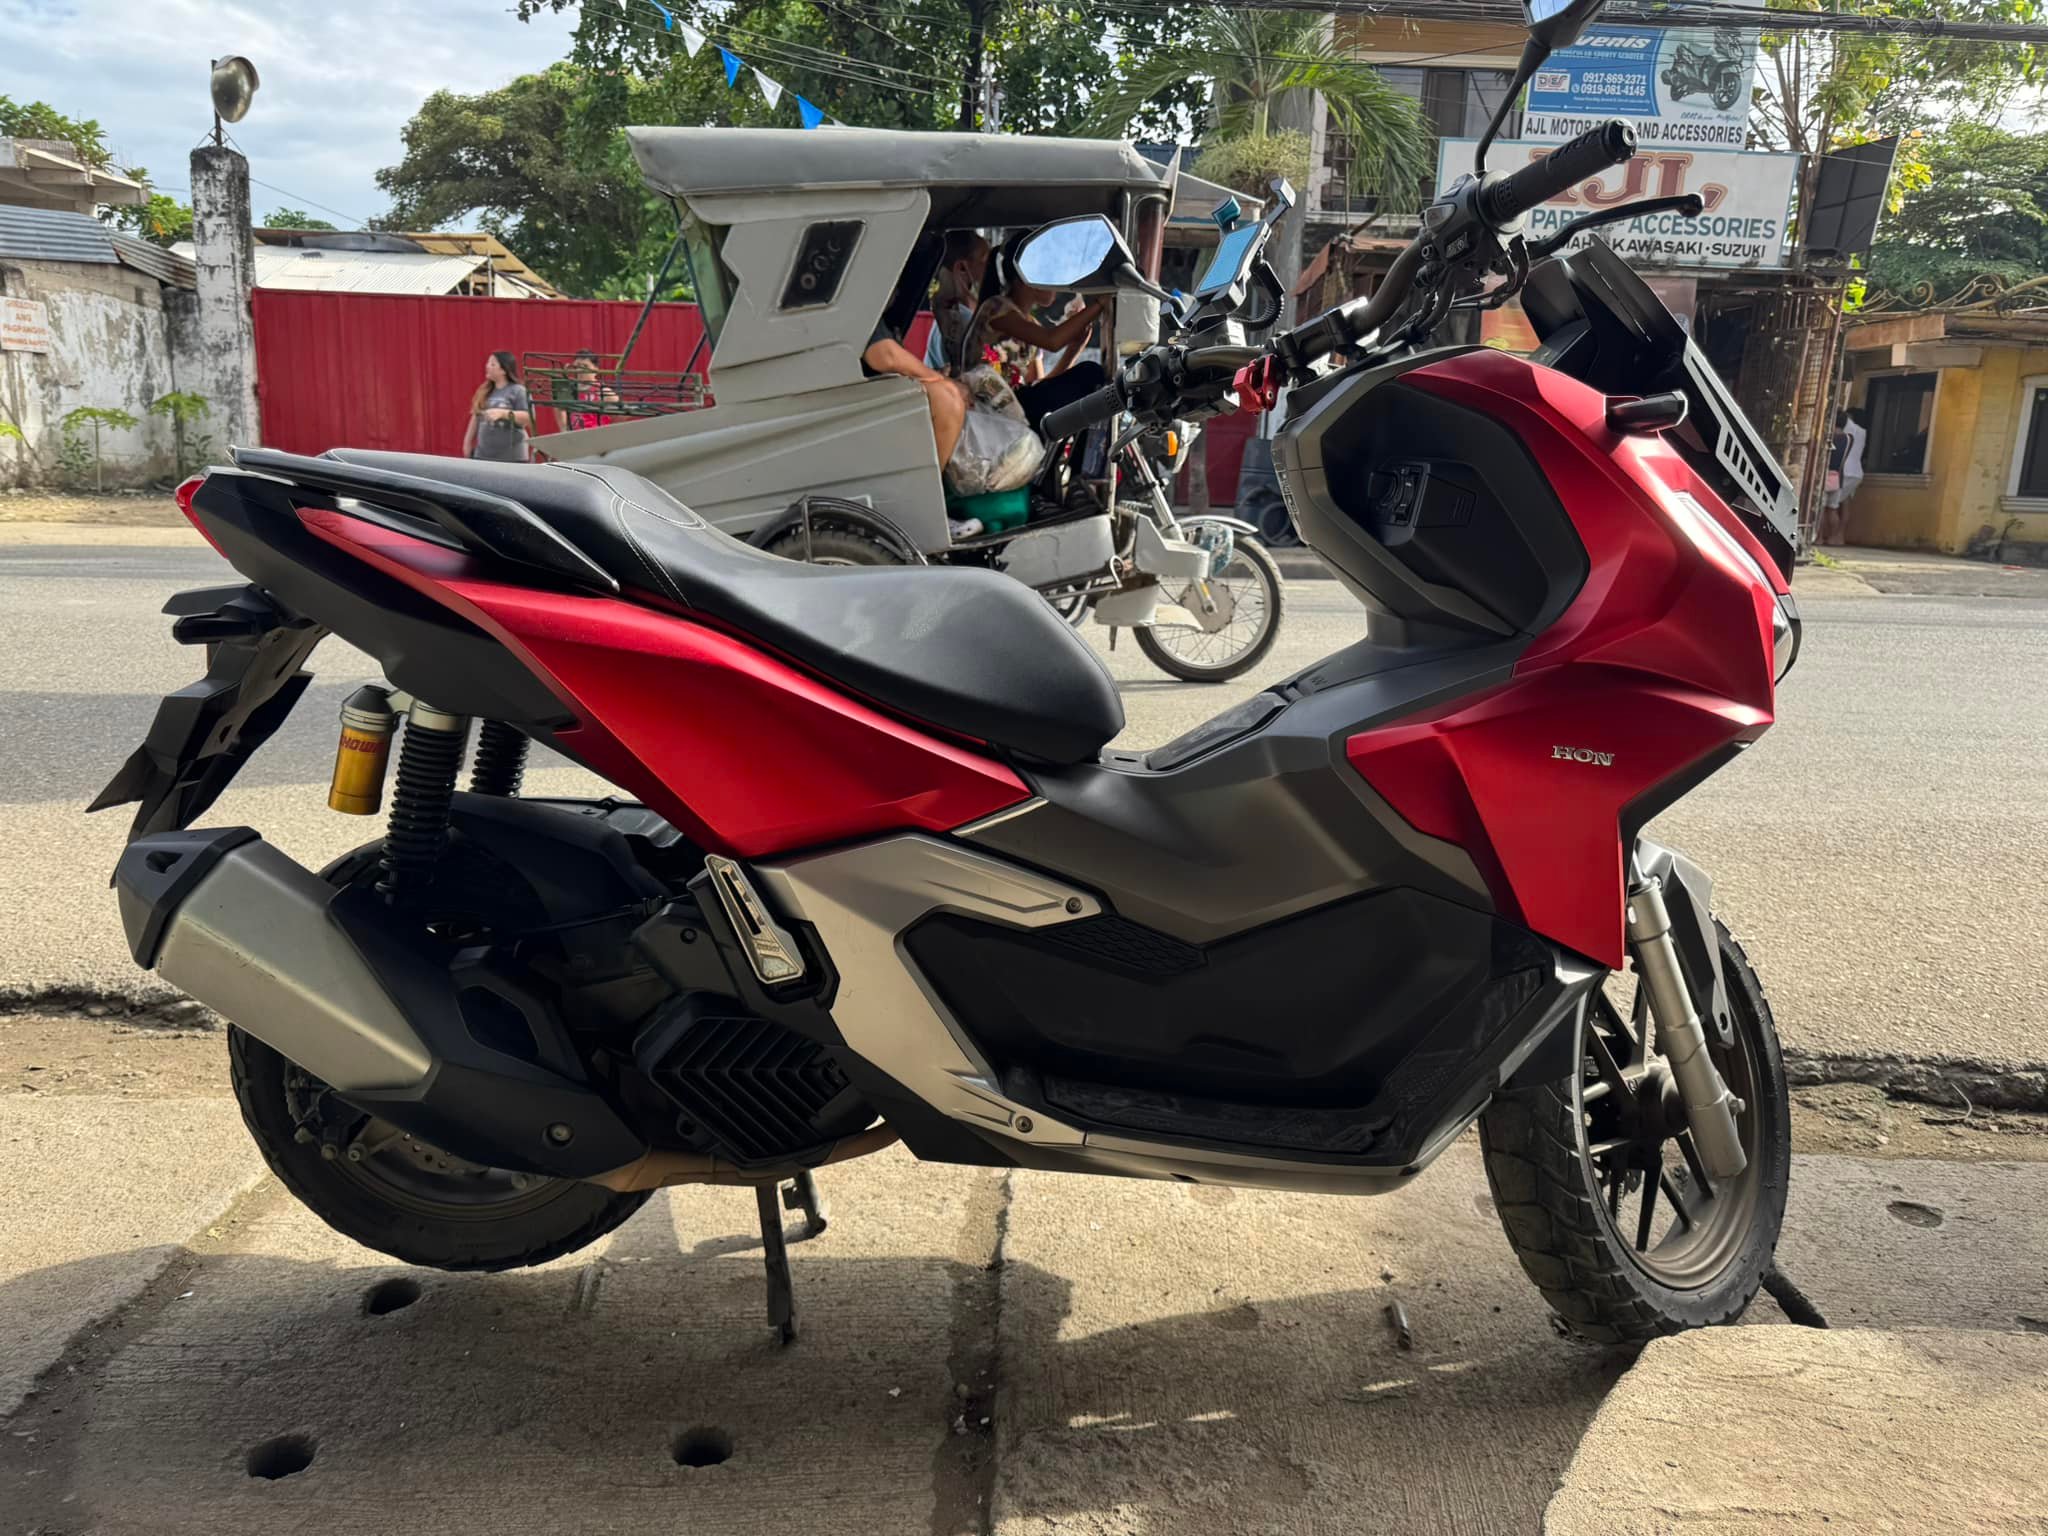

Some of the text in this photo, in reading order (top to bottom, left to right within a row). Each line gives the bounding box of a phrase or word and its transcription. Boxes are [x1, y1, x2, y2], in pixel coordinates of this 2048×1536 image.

[1574, 35, 1651, 49] venis
[1525, 118, 1547, 135] AJL
[1662, 127, 1743, 143] ACCESSORIES
[1628, 217, 1777, 240] ACCESSORIES
[1612, 237, 1703, 256] KAWASAKI
[1711, 242, 1766, 259] SUZUKI
[1551, 745, 1615, 766] HON
